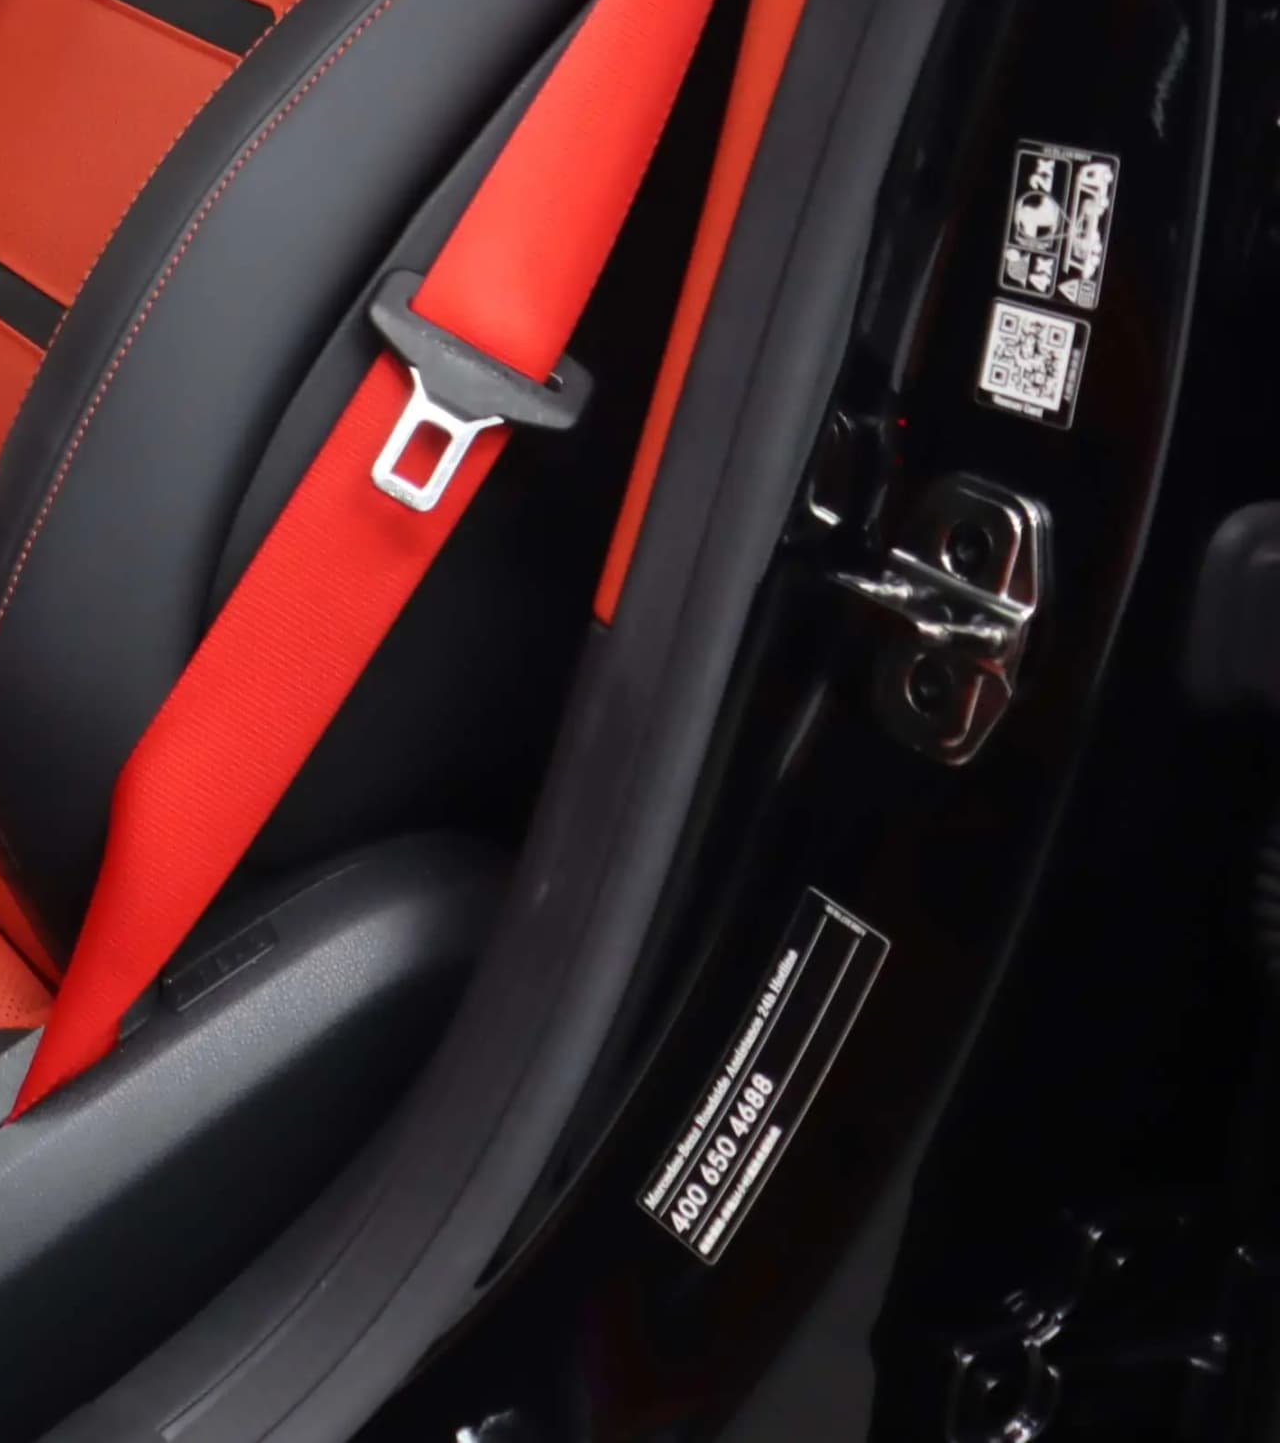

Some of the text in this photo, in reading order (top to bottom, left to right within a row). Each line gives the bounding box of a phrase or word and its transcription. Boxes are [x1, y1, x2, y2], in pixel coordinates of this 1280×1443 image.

[643, 1124, 702, 1212] Mercedes-Benz
[756, 991, 777, 1020] 24h
[671, 1182, 708, 1234] 400
[699, 1134, 737, 1186] 650
[728, 1072, 773, 1138] 4688
